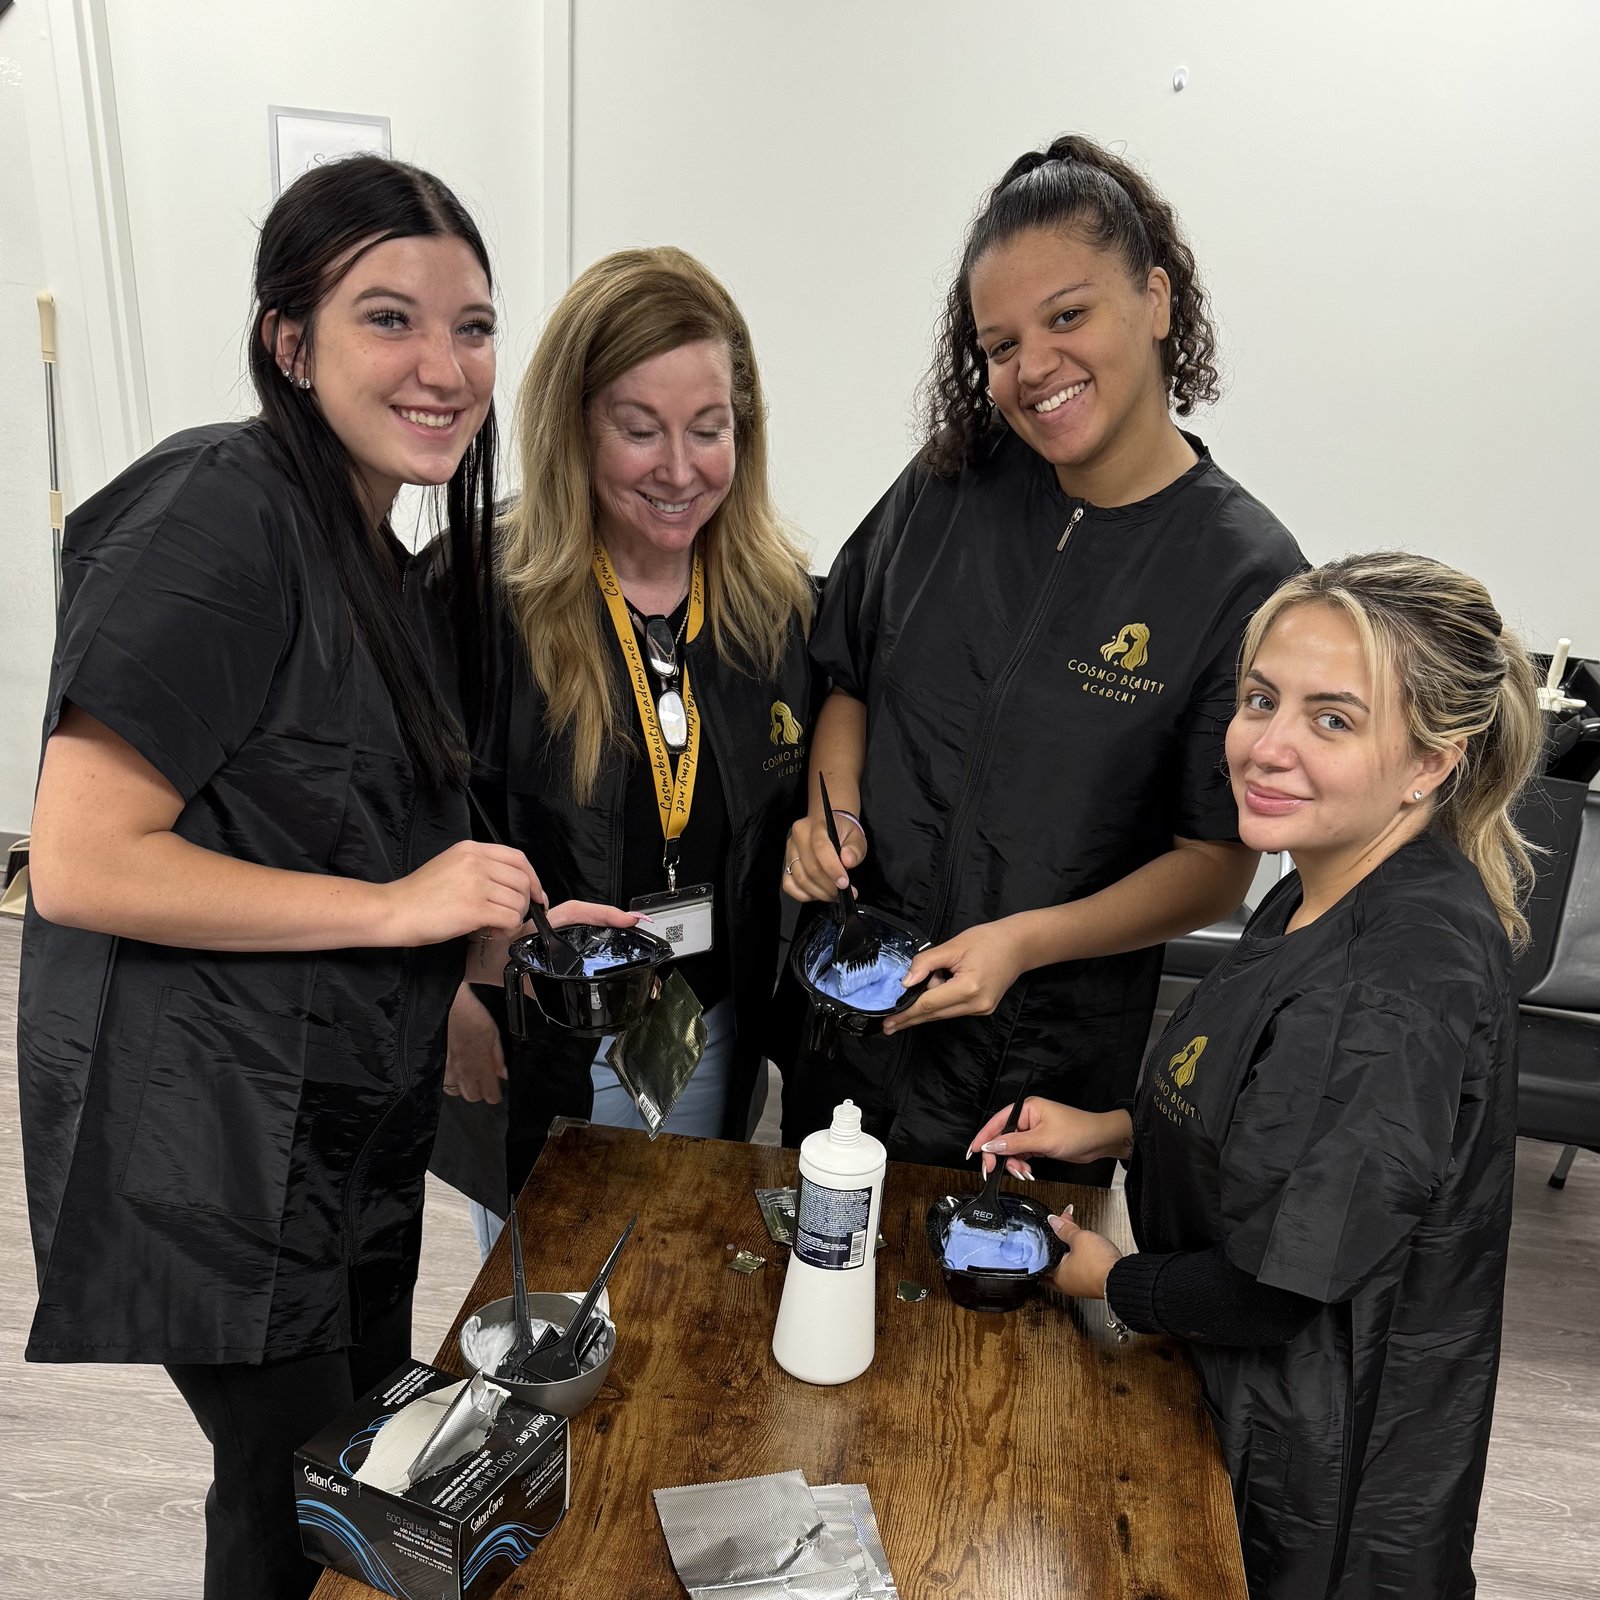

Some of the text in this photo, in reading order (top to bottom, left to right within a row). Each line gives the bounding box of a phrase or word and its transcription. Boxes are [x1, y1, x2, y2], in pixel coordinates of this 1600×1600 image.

[1068, 659, 1165, 694] COSMO BEAUTY
[1082, 682, 1137, 704] ACADEMY
[623, 638, 672, 810] Cosmobeautyacademy.net
[762, 751, 791, 771] COSMO
[973, 1209, 994, 1220] RED
[515, 1412, 556, 1444] SalonCare
[480, 1449, 491, 1459] 500
[481, 1458, 493, 1468] 500
[303, 1465, 348, 1497] SalonCare
[448, 1450, 518, 1512] 500 Foil Half Sheets
[386, 1511, 453, 1547] 500 Foil Half Sheets
[470, 1496, 504, 1533] SalonCare
